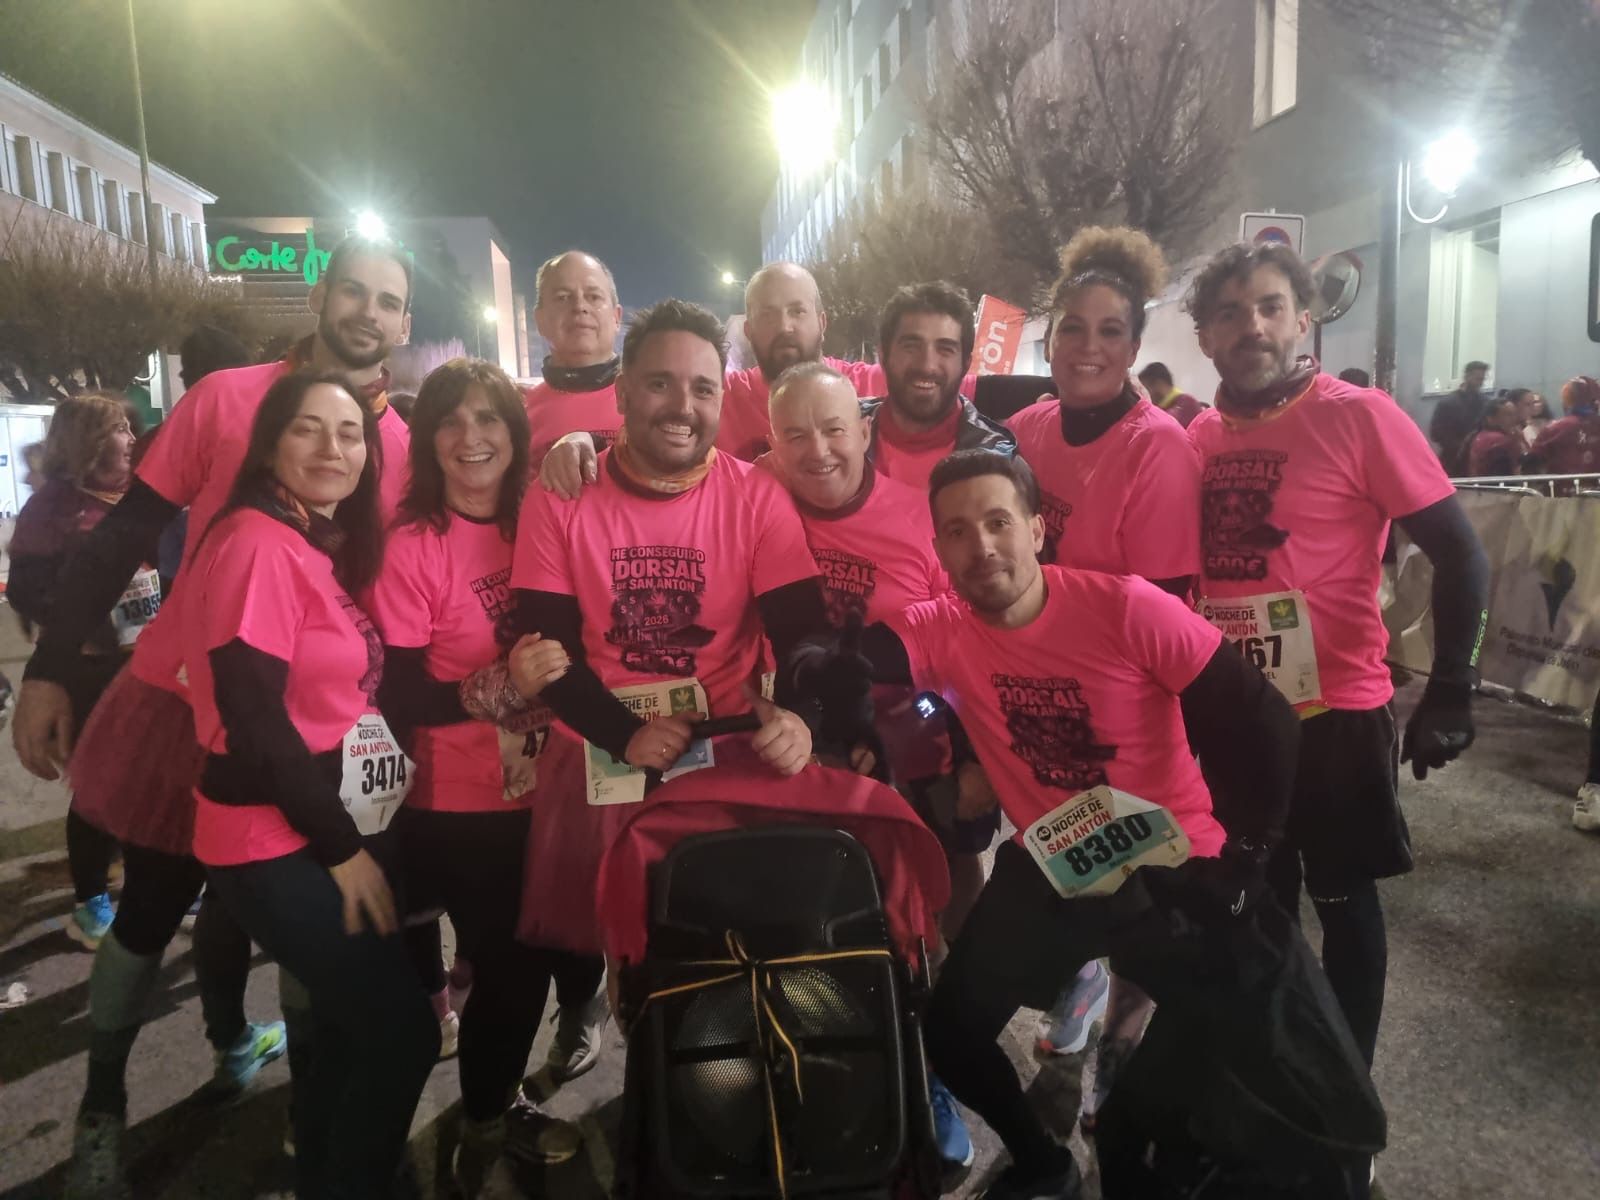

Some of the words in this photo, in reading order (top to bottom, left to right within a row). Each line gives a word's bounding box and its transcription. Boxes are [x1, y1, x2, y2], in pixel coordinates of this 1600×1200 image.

[611, 548, 627, 561] HE
[629, 547, 705, 562] CONSEGUIDO
[614, 559, 705, 583] DORSAL
[819, 559, 875, 588] RSAL
[471, 578, 487, 592] HE
[629, 579, 654, 591] SAN
[644, 614, 670, 627] 2026
[1241, 609, 1256, 620] DE
[644, 696, 659, 708] DE
[349, 743, 368, 758] SAN
[361, 753, 407, 795] 3474
[1052, 806, 1089, 836] NOCHE
[1088, 799, 1104, 815] DE
[1046, 833, 1073, 856] SAN
[1073, 810, 1113, 843] ANTÓN
[1064, 814, 1152, 877] 8380
